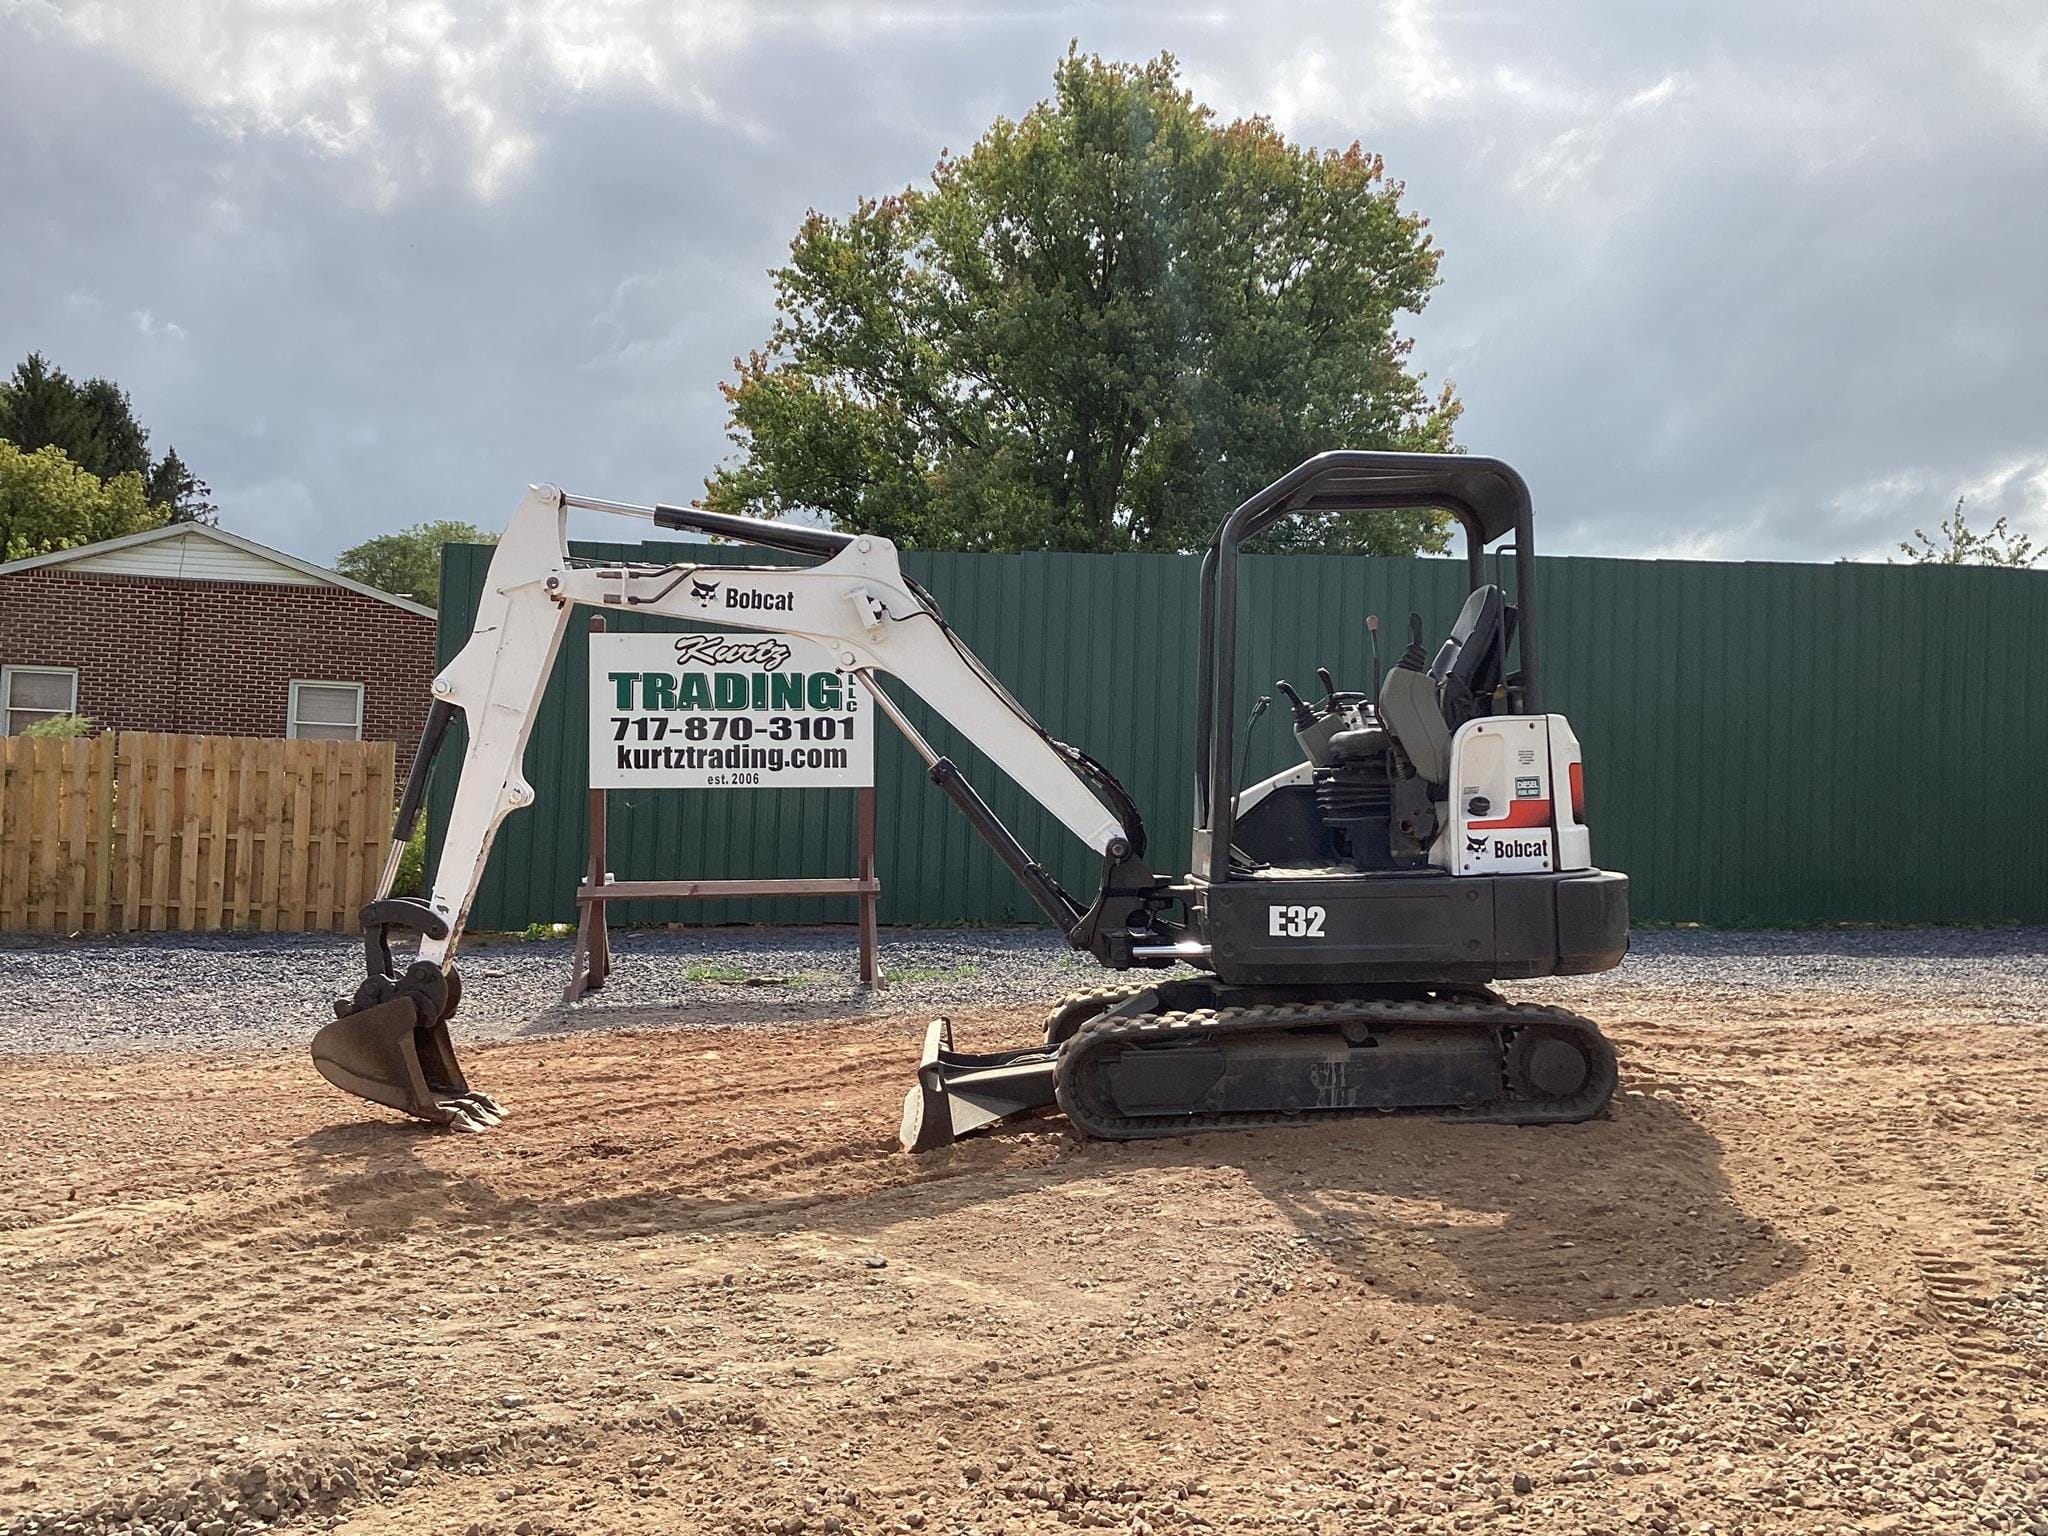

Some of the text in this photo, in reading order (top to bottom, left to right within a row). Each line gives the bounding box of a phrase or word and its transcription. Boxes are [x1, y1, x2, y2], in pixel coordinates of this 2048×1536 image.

[725, 587, 794, 612] Bobcat
[674, 635, 791, 672] Kurtz
[608, 671, 843, 712] TRADING
[847, 673, 857, 713] LLC
[610, 716, 854, 741] 717-870-3101
[617, 744, 848, 772] kurtztrading.com
[707, 773, 760, 785] est. 2006
[1517, 781, 1538, 789] DIESEL
[1494, 840, 1548, 859] Bobcat
[1269, 905, 1326, 937] E32
